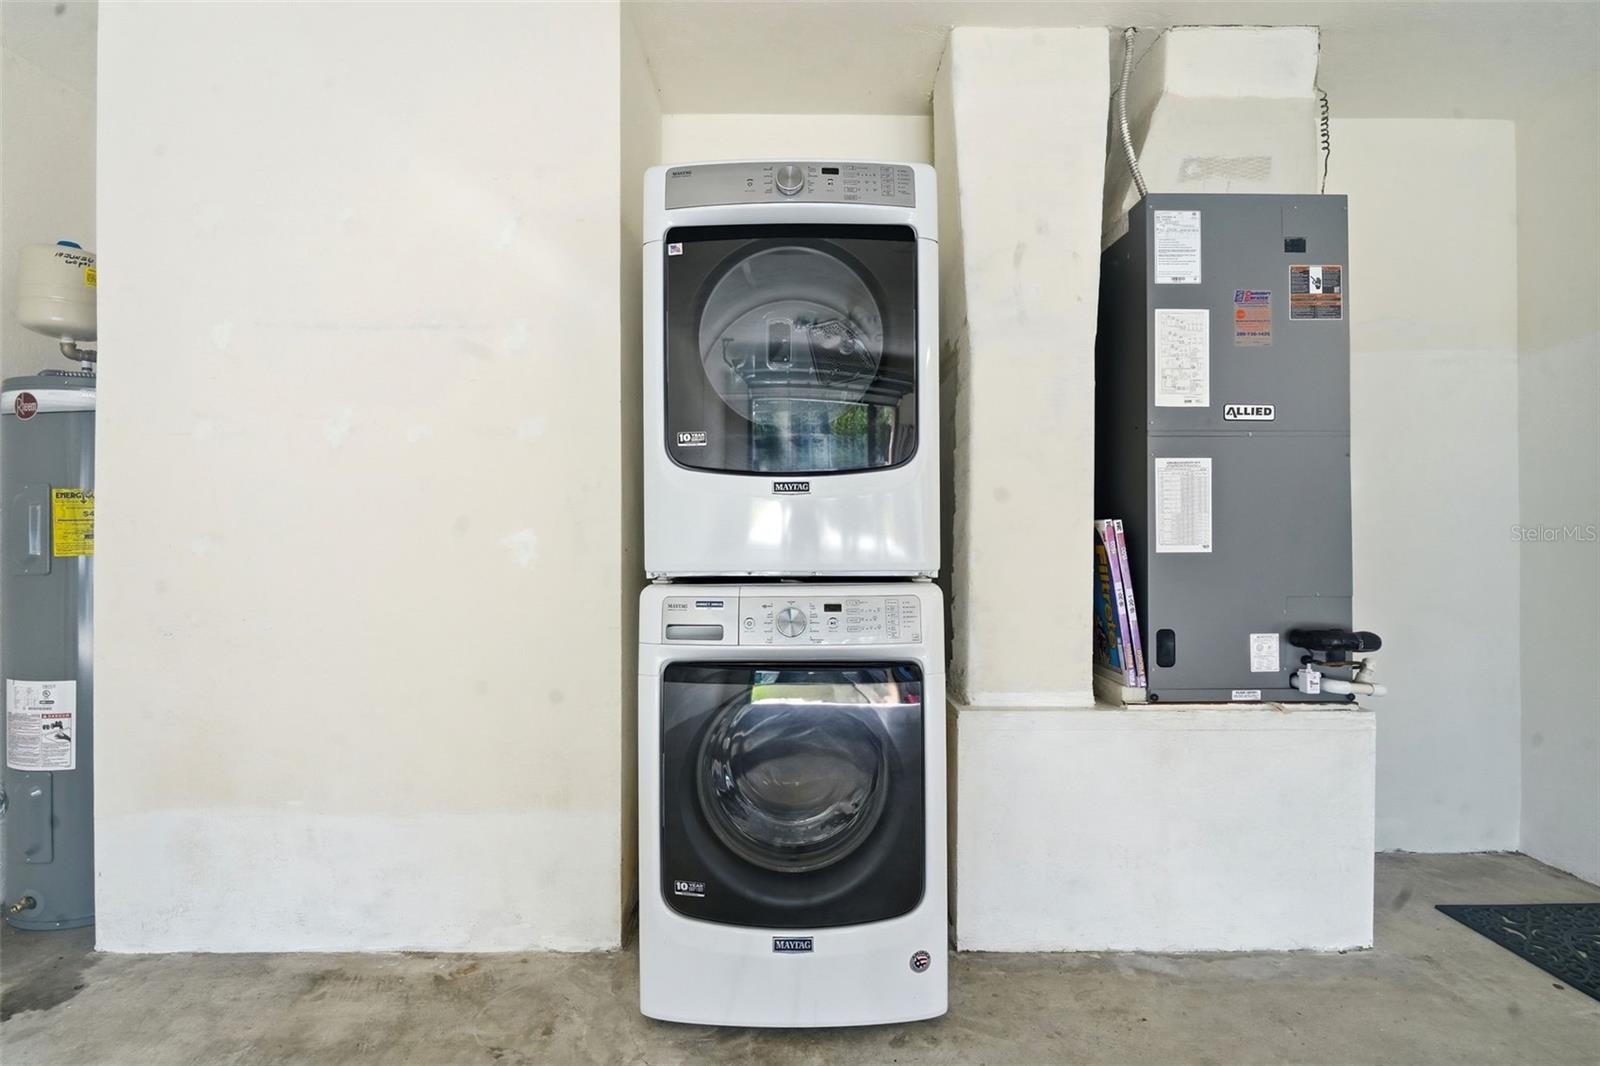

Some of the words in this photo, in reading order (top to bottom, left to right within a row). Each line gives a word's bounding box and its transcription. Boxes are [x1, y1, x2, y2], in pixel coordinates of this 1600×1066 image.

[17, 393, 36, 415] Rheem
[1226, 407, 1272, 418] ALLIED
[679, 433, 691, 442] 10
[775, 483, 809, 491] MAYTAG
[676, 881, 688, 891] 10
[776, 941, 811, 949] MAYTAG
